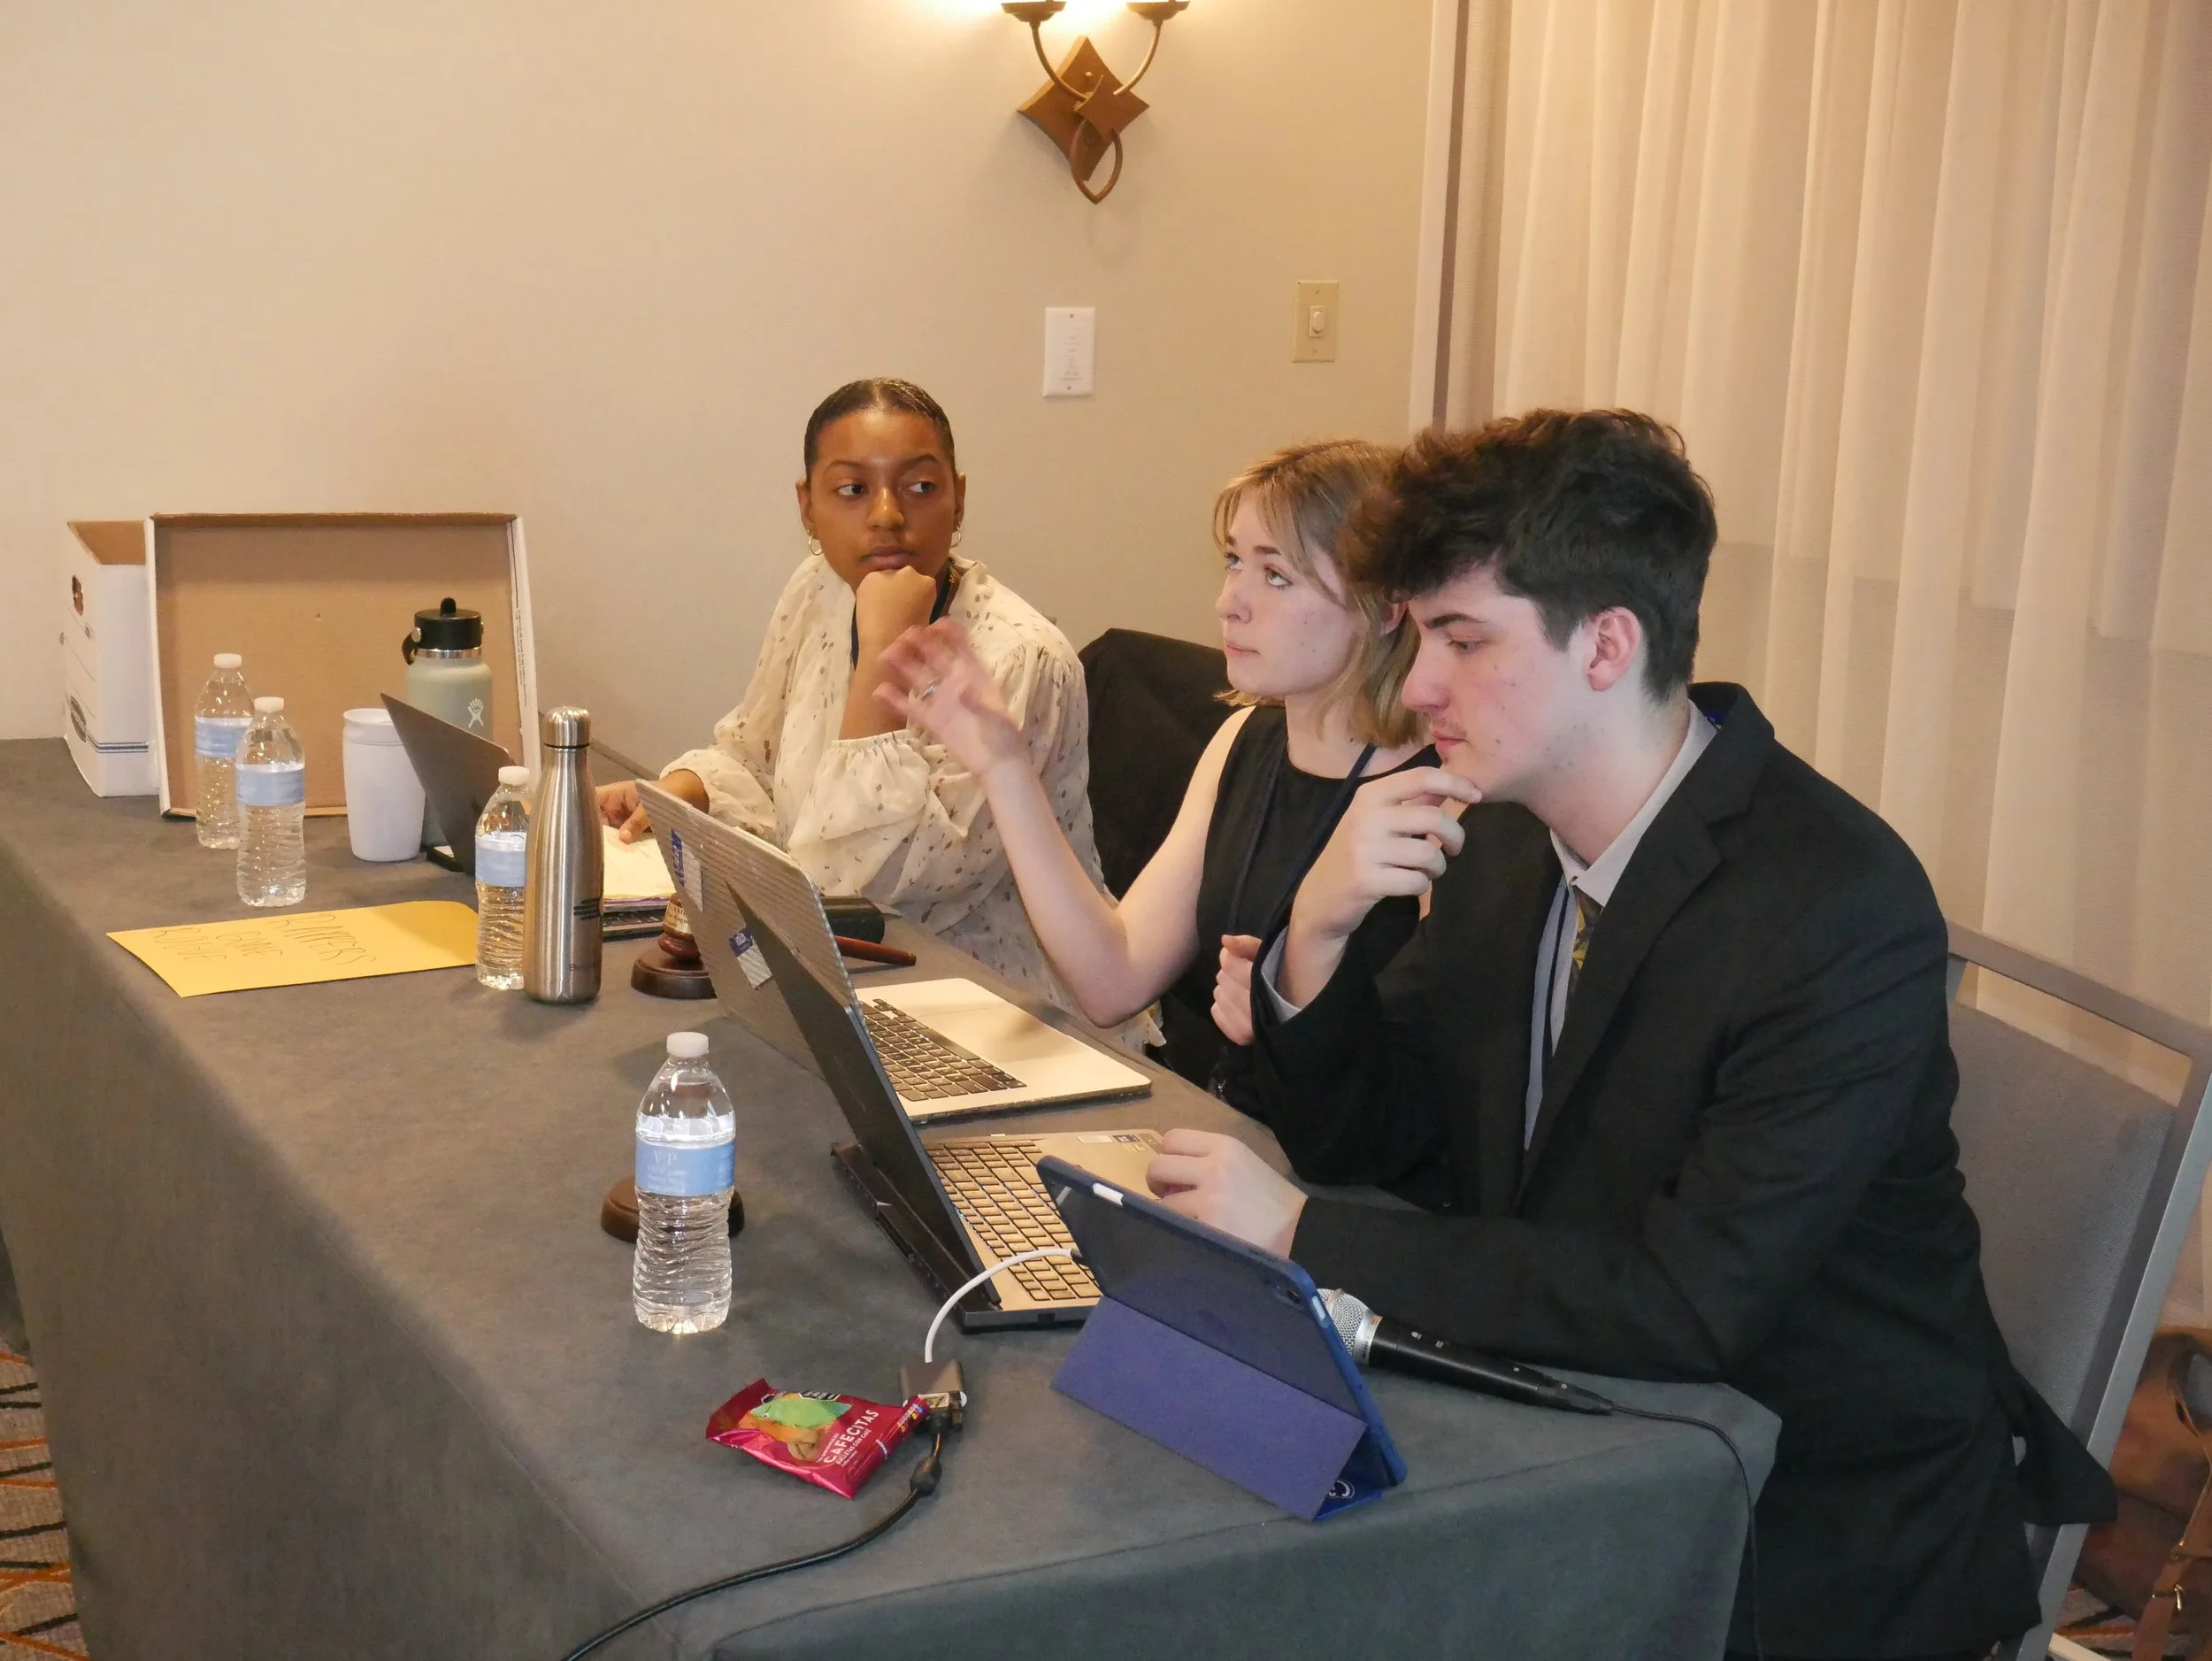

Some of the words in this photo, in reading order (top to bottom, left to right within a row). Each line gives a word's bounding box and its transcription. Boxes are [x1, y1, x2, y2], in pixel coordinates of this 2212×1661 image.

[153, 927, 227, 963] ROGUE
[217, 931, 283, 958] GONE
[267, 913, 376, 965] RAPPERS
[824, 1409, 879, 1464] CAFECITAS
[835, 1446, 856, 1465] GALLETAS
[853, 1437, 863, 1447] CON
